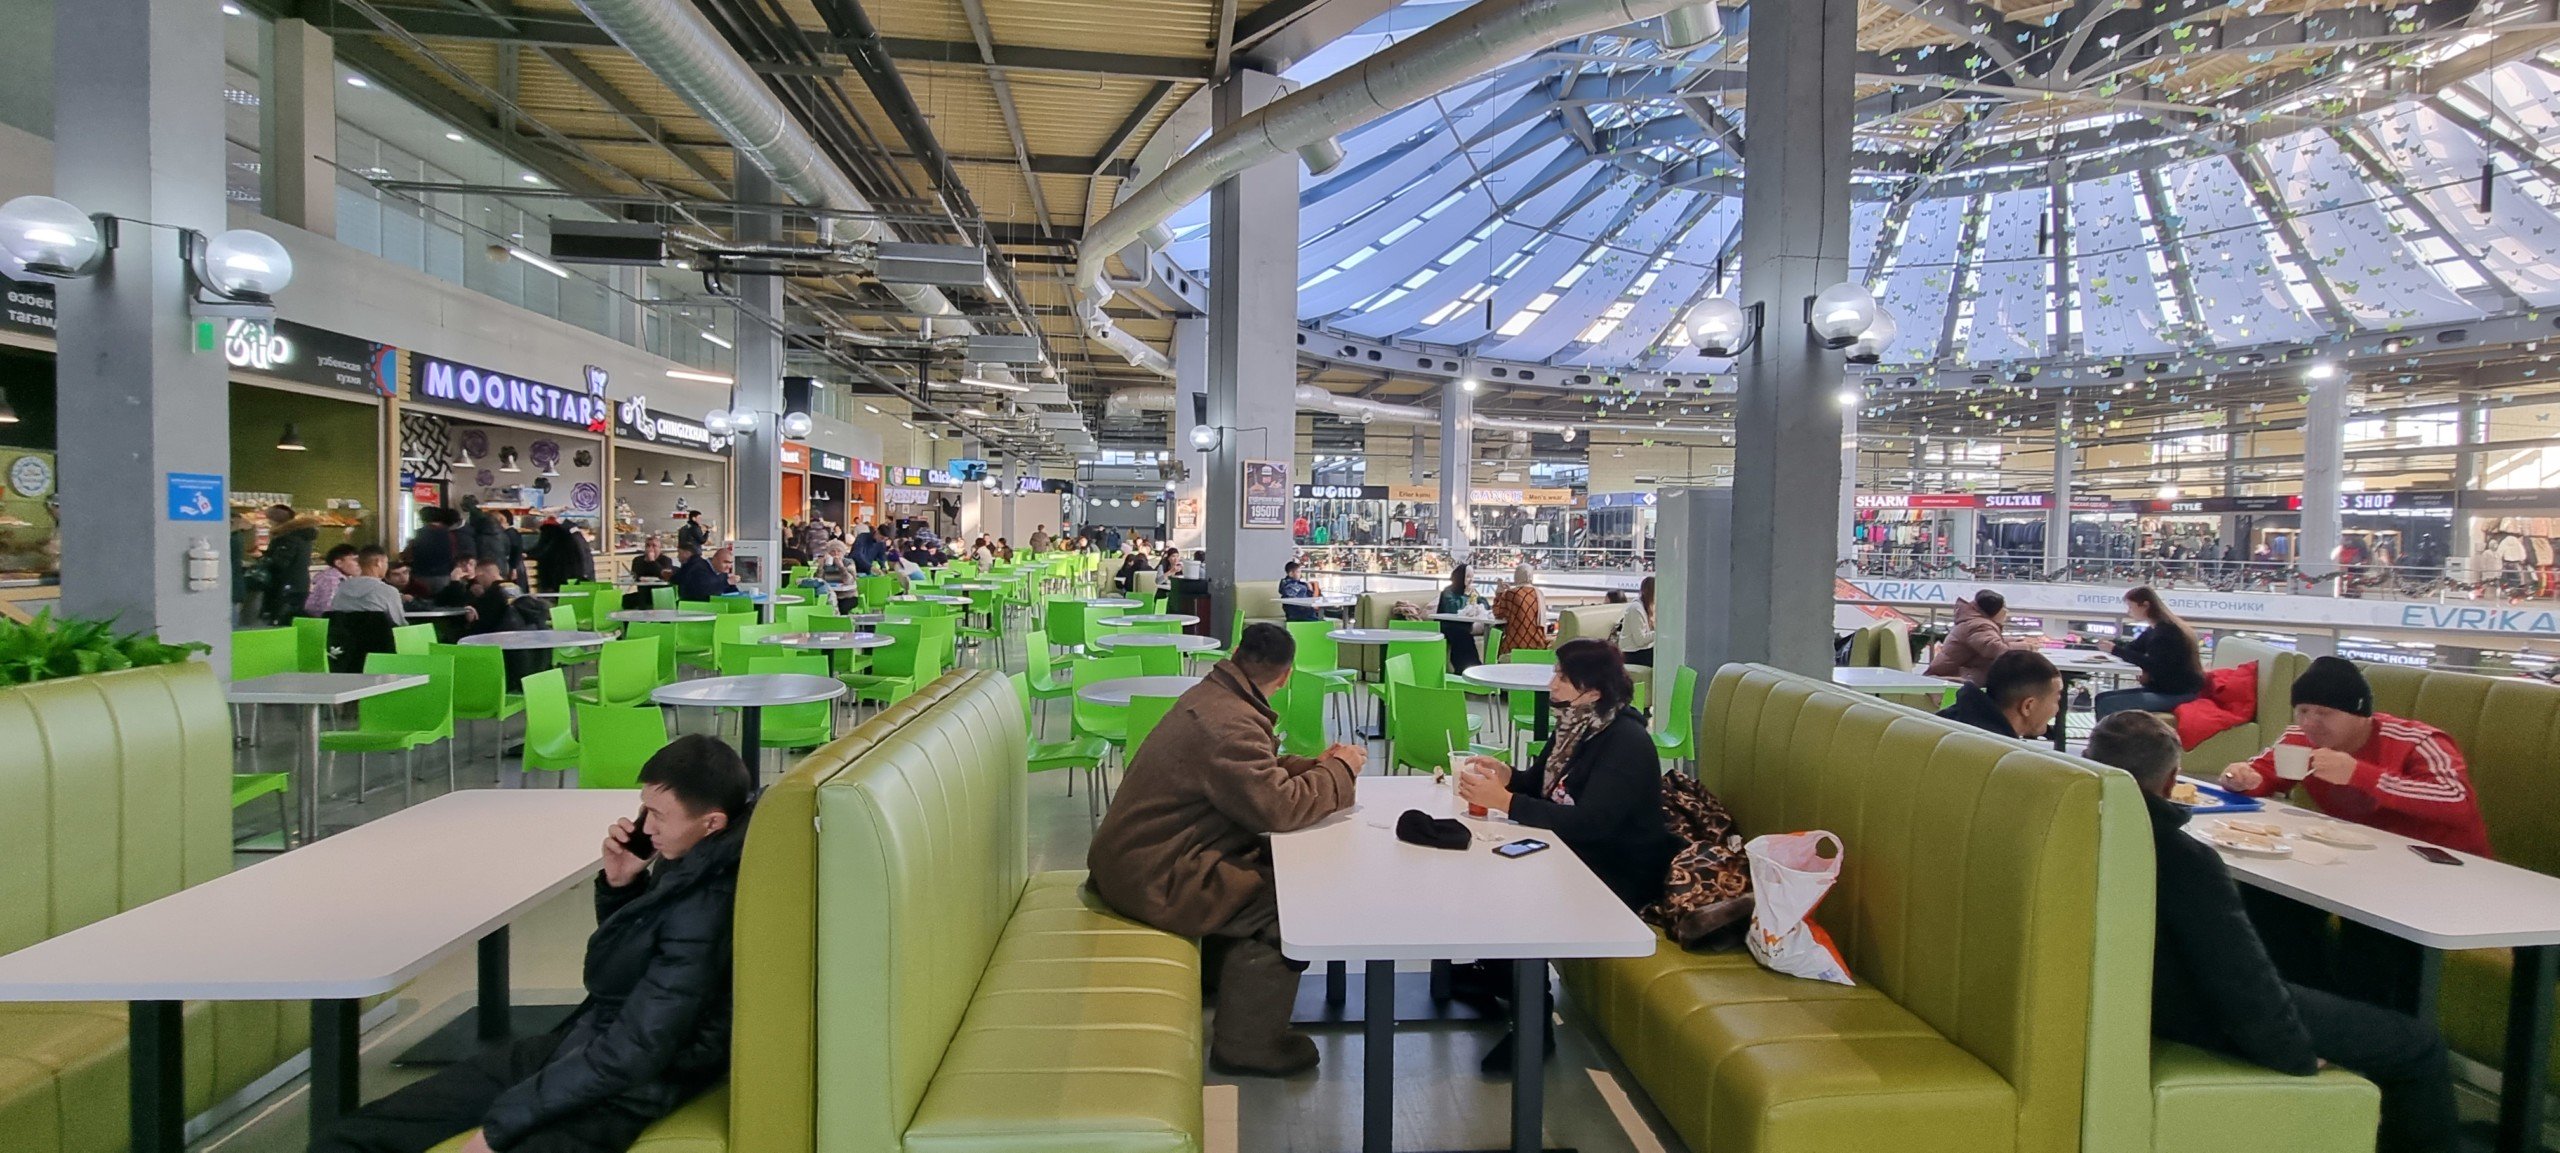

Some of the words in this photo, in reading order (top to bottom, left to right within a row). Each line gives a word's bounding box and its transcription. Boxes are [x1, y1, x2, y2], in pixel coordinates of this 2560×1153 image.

[7, 291, 54, 310] өзбек
[336, 374, 361, 386] кухня
[423, 361, 592, 426] MOONSTAR
[1312, 485, 1363, 498] WORLD
[1855, 495, 1909, 507] SHARM
[1985, 494, 2043, 508] SULTAN
[2171, 502, 2203, 511] STYLE
[2354, 494, 2395, 509] SHOP
[2168, 598, 2265, 612] ЭЛЕКТРОНИКИ
